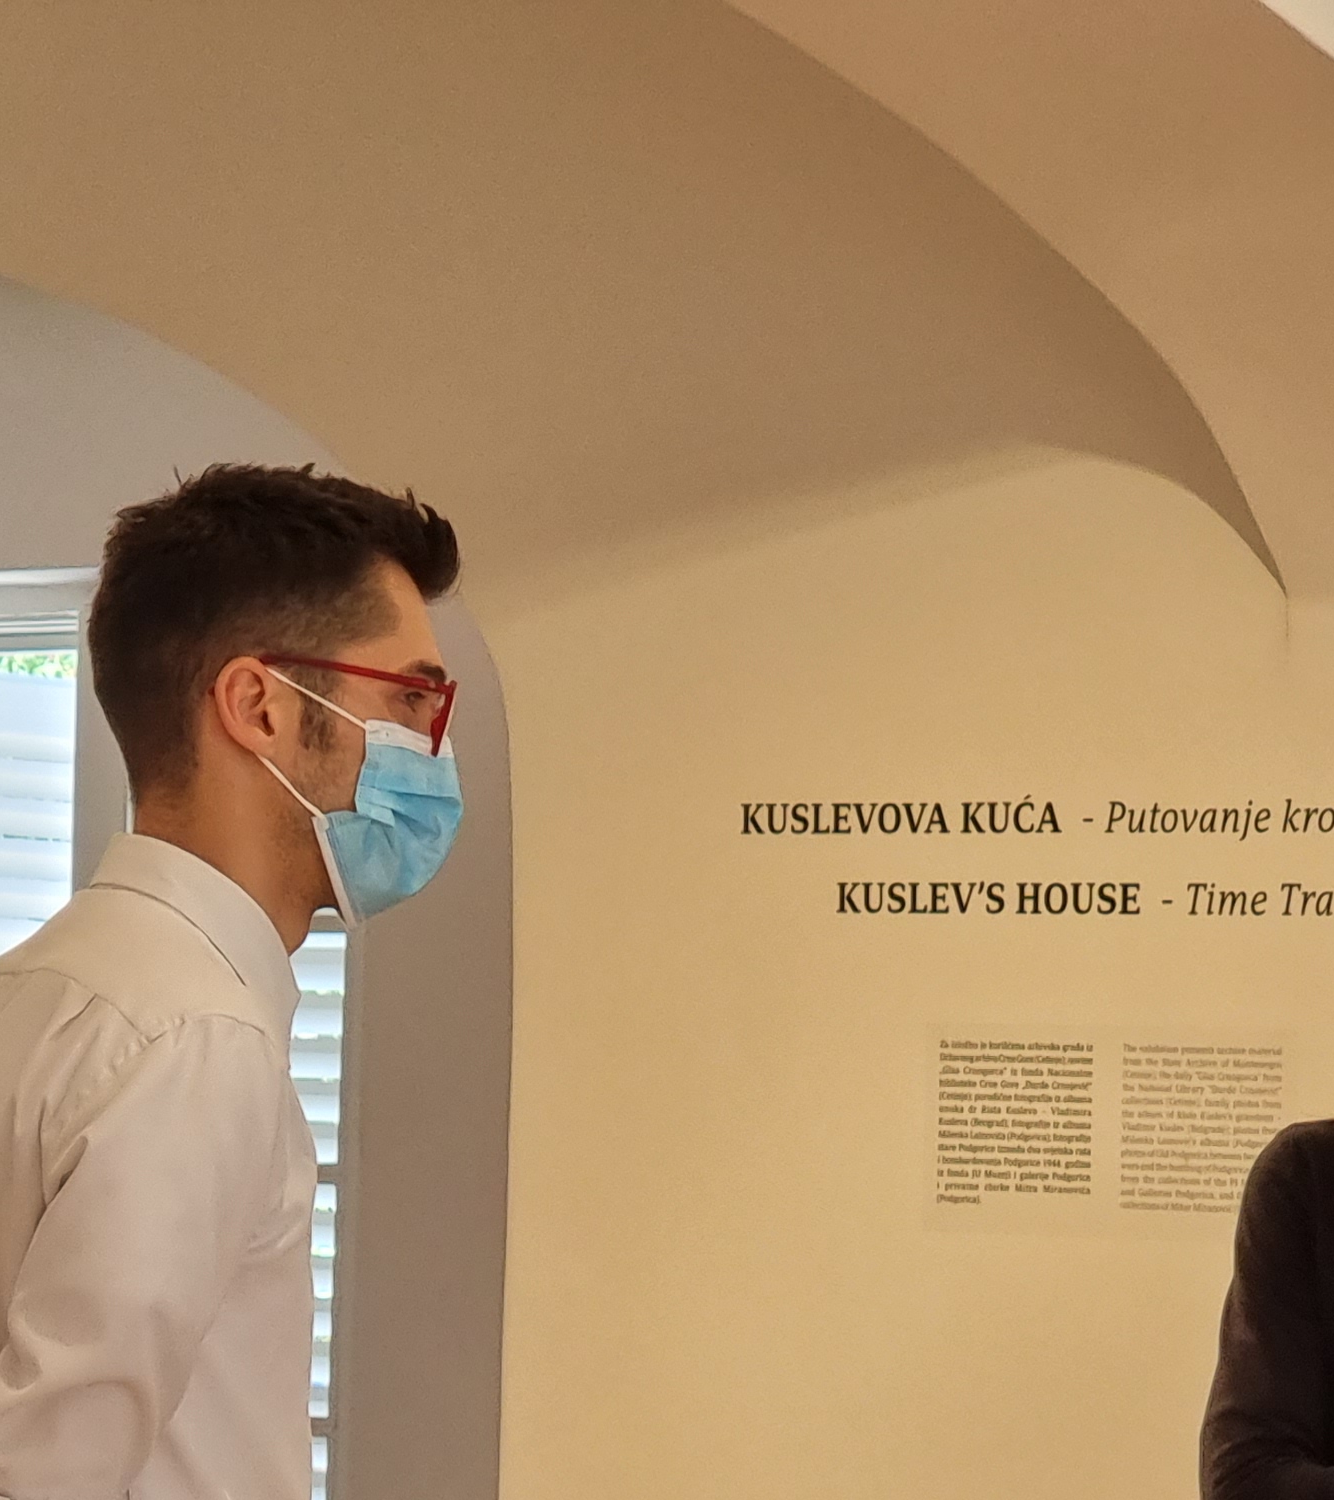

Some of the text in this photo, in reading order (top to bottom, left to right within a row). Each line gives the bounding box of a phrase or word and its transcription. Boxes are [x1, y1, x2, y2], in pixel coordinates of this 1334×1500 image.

[740, 802, 951, 835] KUSLEVOVA
[960, 794, 1063, 834] KUĆA
[1104, 799, 1271, 842] Putovanje
[1015, 882, 1141, 915] HOUSE
[1186, 882, 1268, 916] Time
